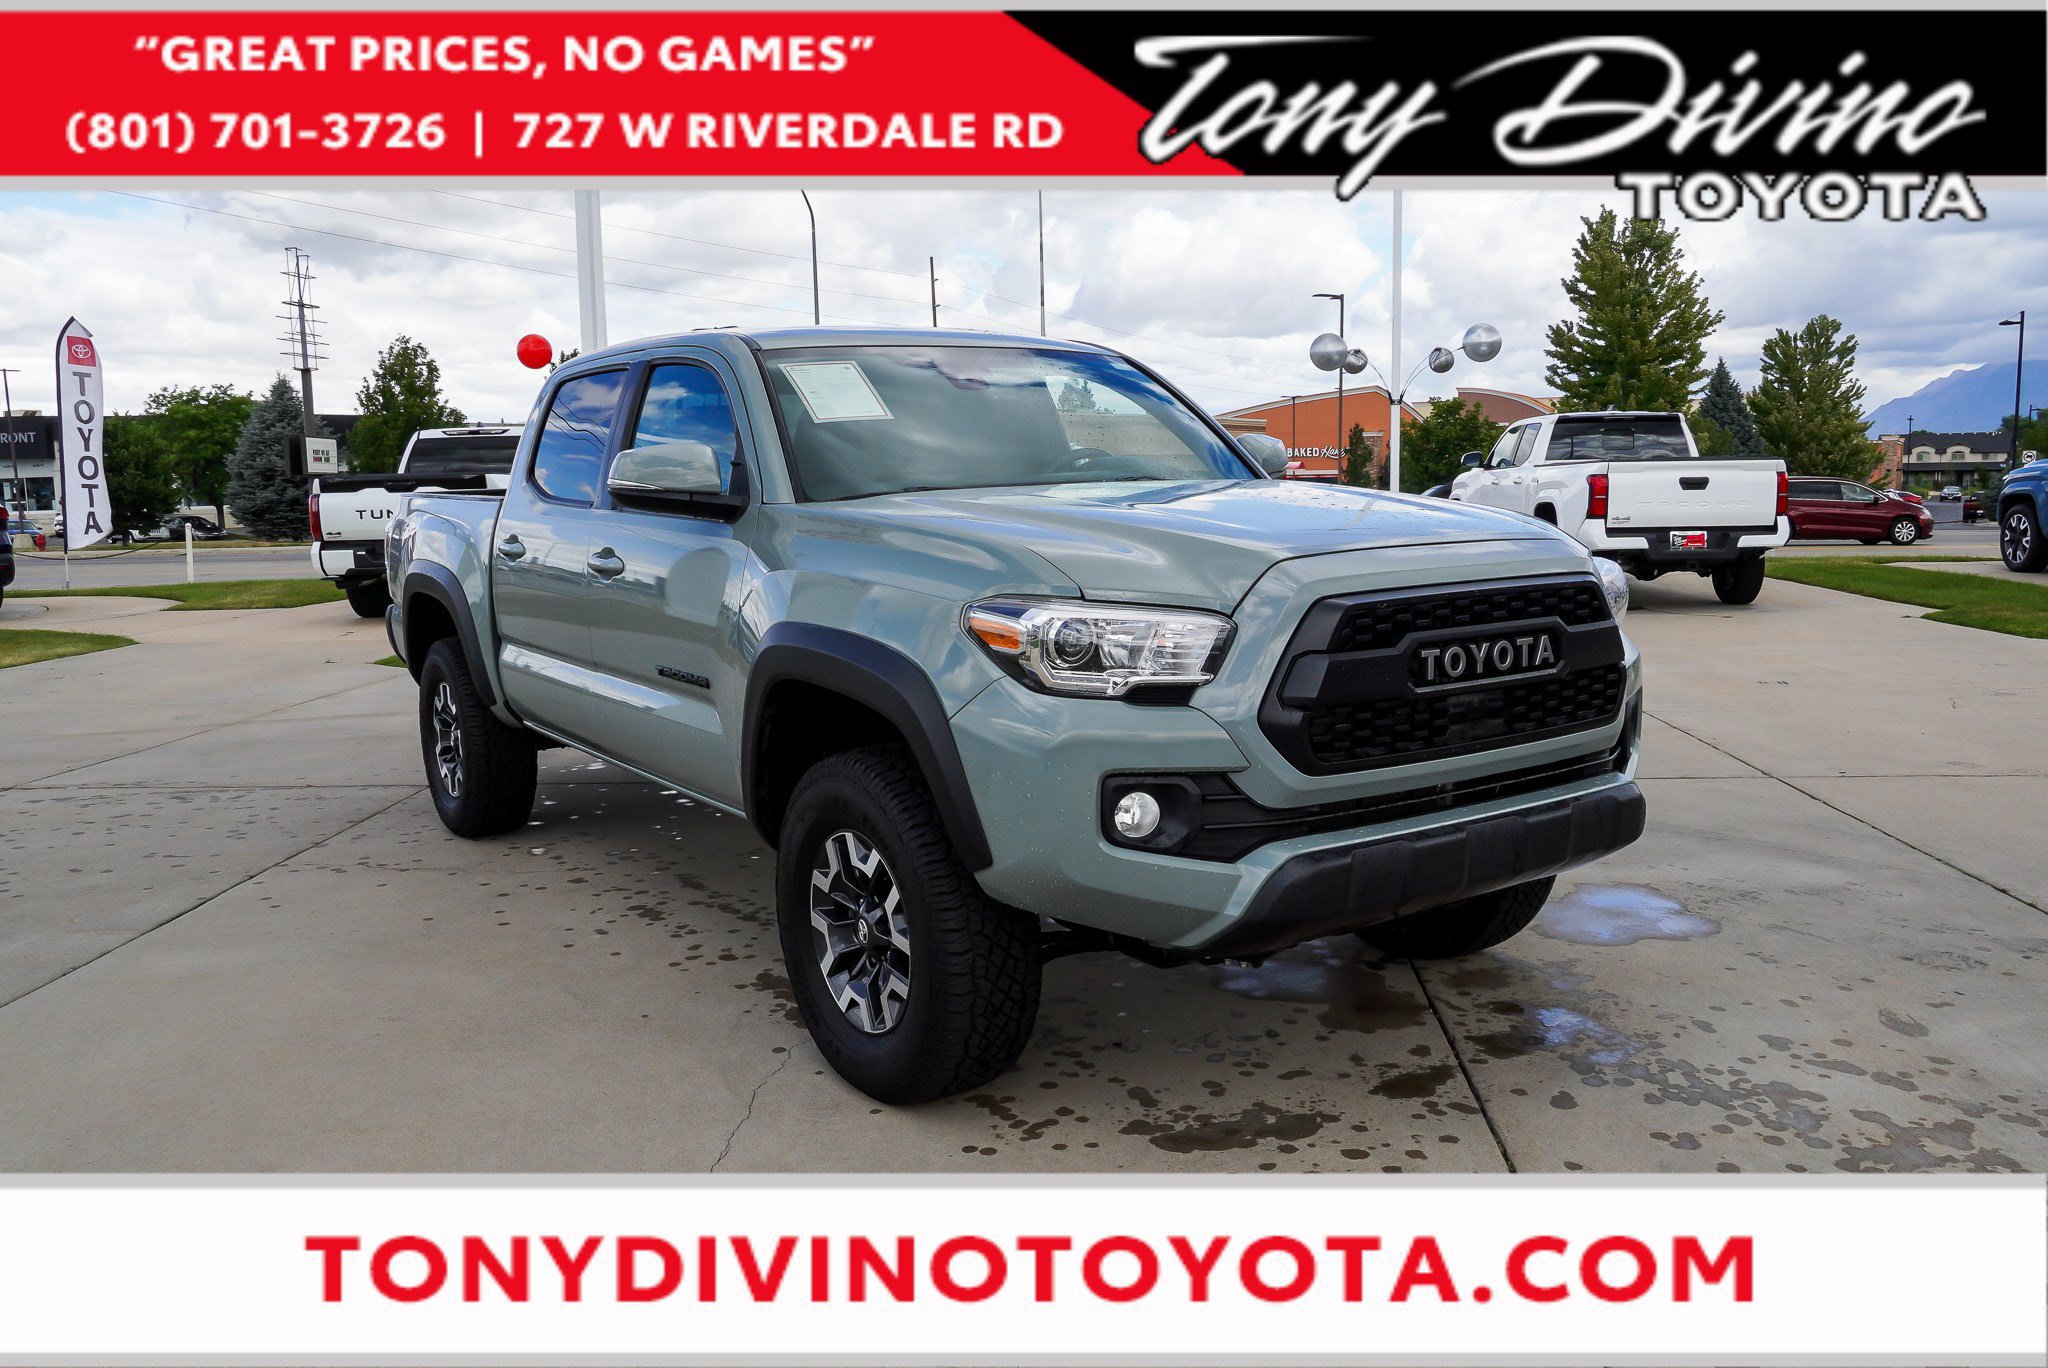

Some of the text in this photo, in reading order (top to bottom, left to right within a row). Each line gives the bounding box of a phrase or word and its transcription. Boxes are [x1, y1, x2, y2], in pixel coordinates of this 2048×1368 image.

[72, 371, 104, 535] TOYOTA
[655, 665, 711, 689] TACOMA
[1421, 635, 1555, 681] TOYOTA
